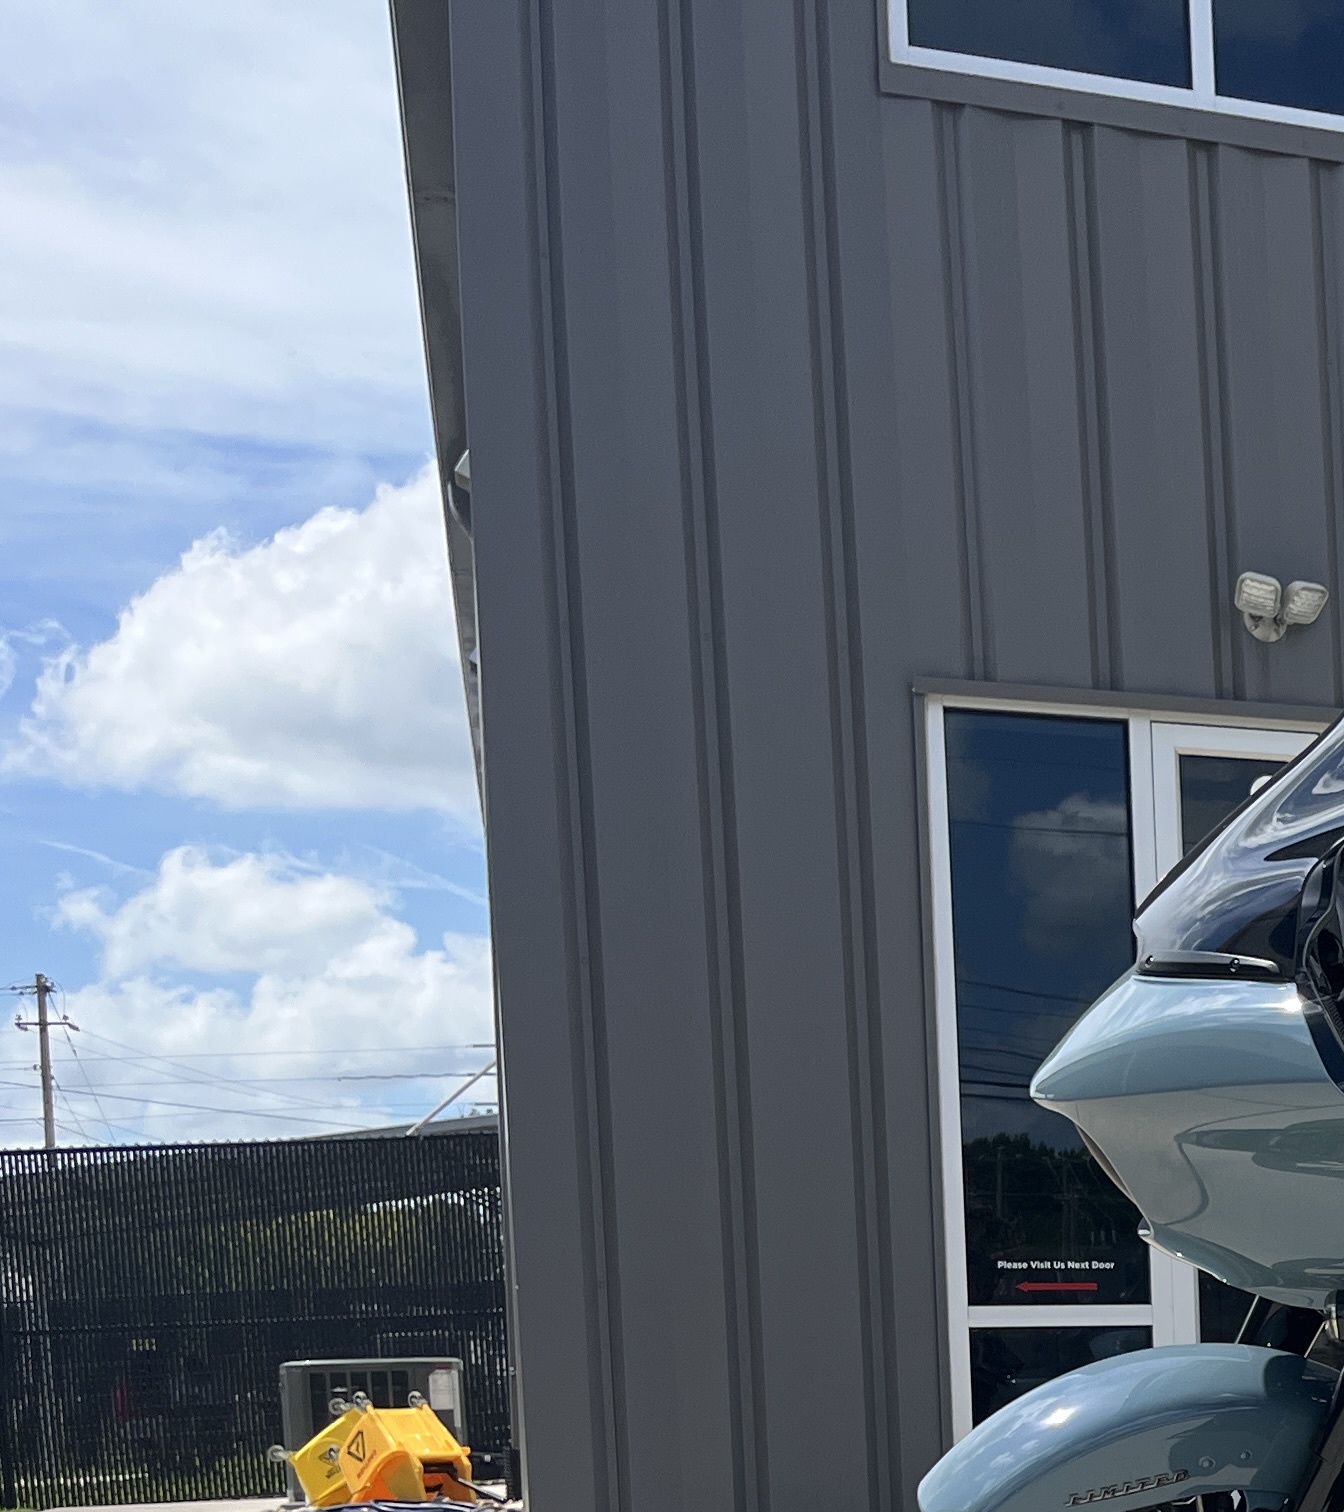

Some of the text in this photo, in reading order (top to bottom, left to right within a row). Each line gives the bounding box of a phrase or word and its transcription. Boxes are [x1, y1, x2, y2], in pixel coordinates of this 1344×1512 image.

[997, 1260, 1115, 1270] Please Visit Us Next Door
[1064, 1468, 1191, 1508] LIMITED
